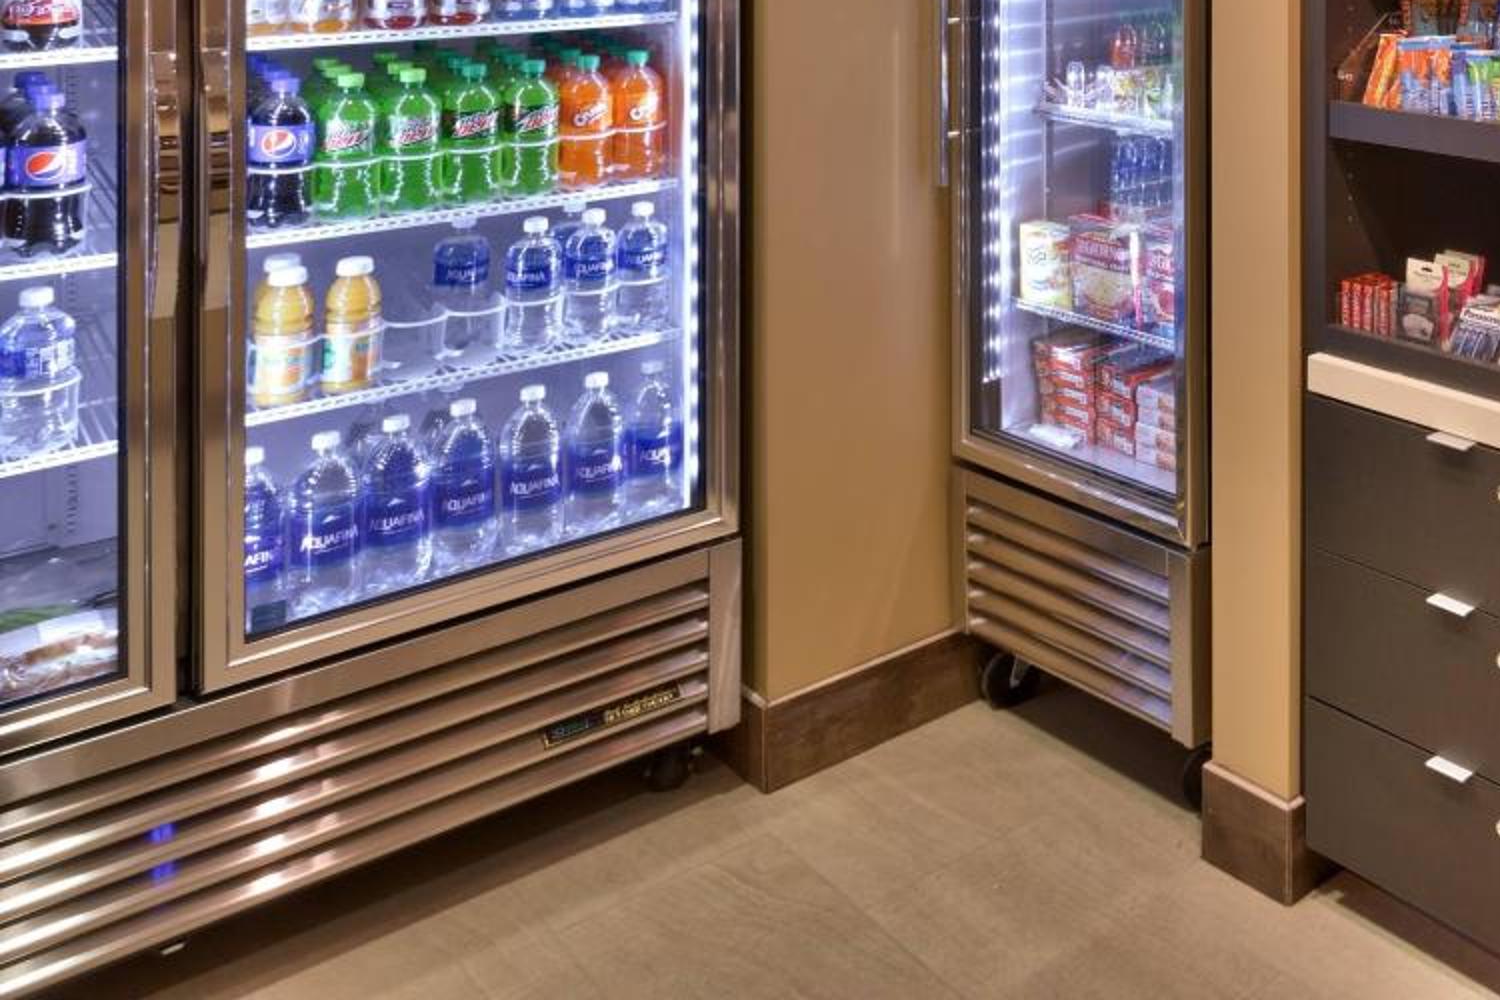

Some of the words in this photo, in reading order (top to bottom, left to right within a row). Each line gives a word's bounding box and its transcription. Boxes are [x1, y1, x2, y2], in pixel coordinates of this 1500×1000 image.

[510, 473, 560, 495] AQUAFINA
[369, 508, 424, 532] AQUAFINA
[300, 524, 358, 552] AQUAFINA
